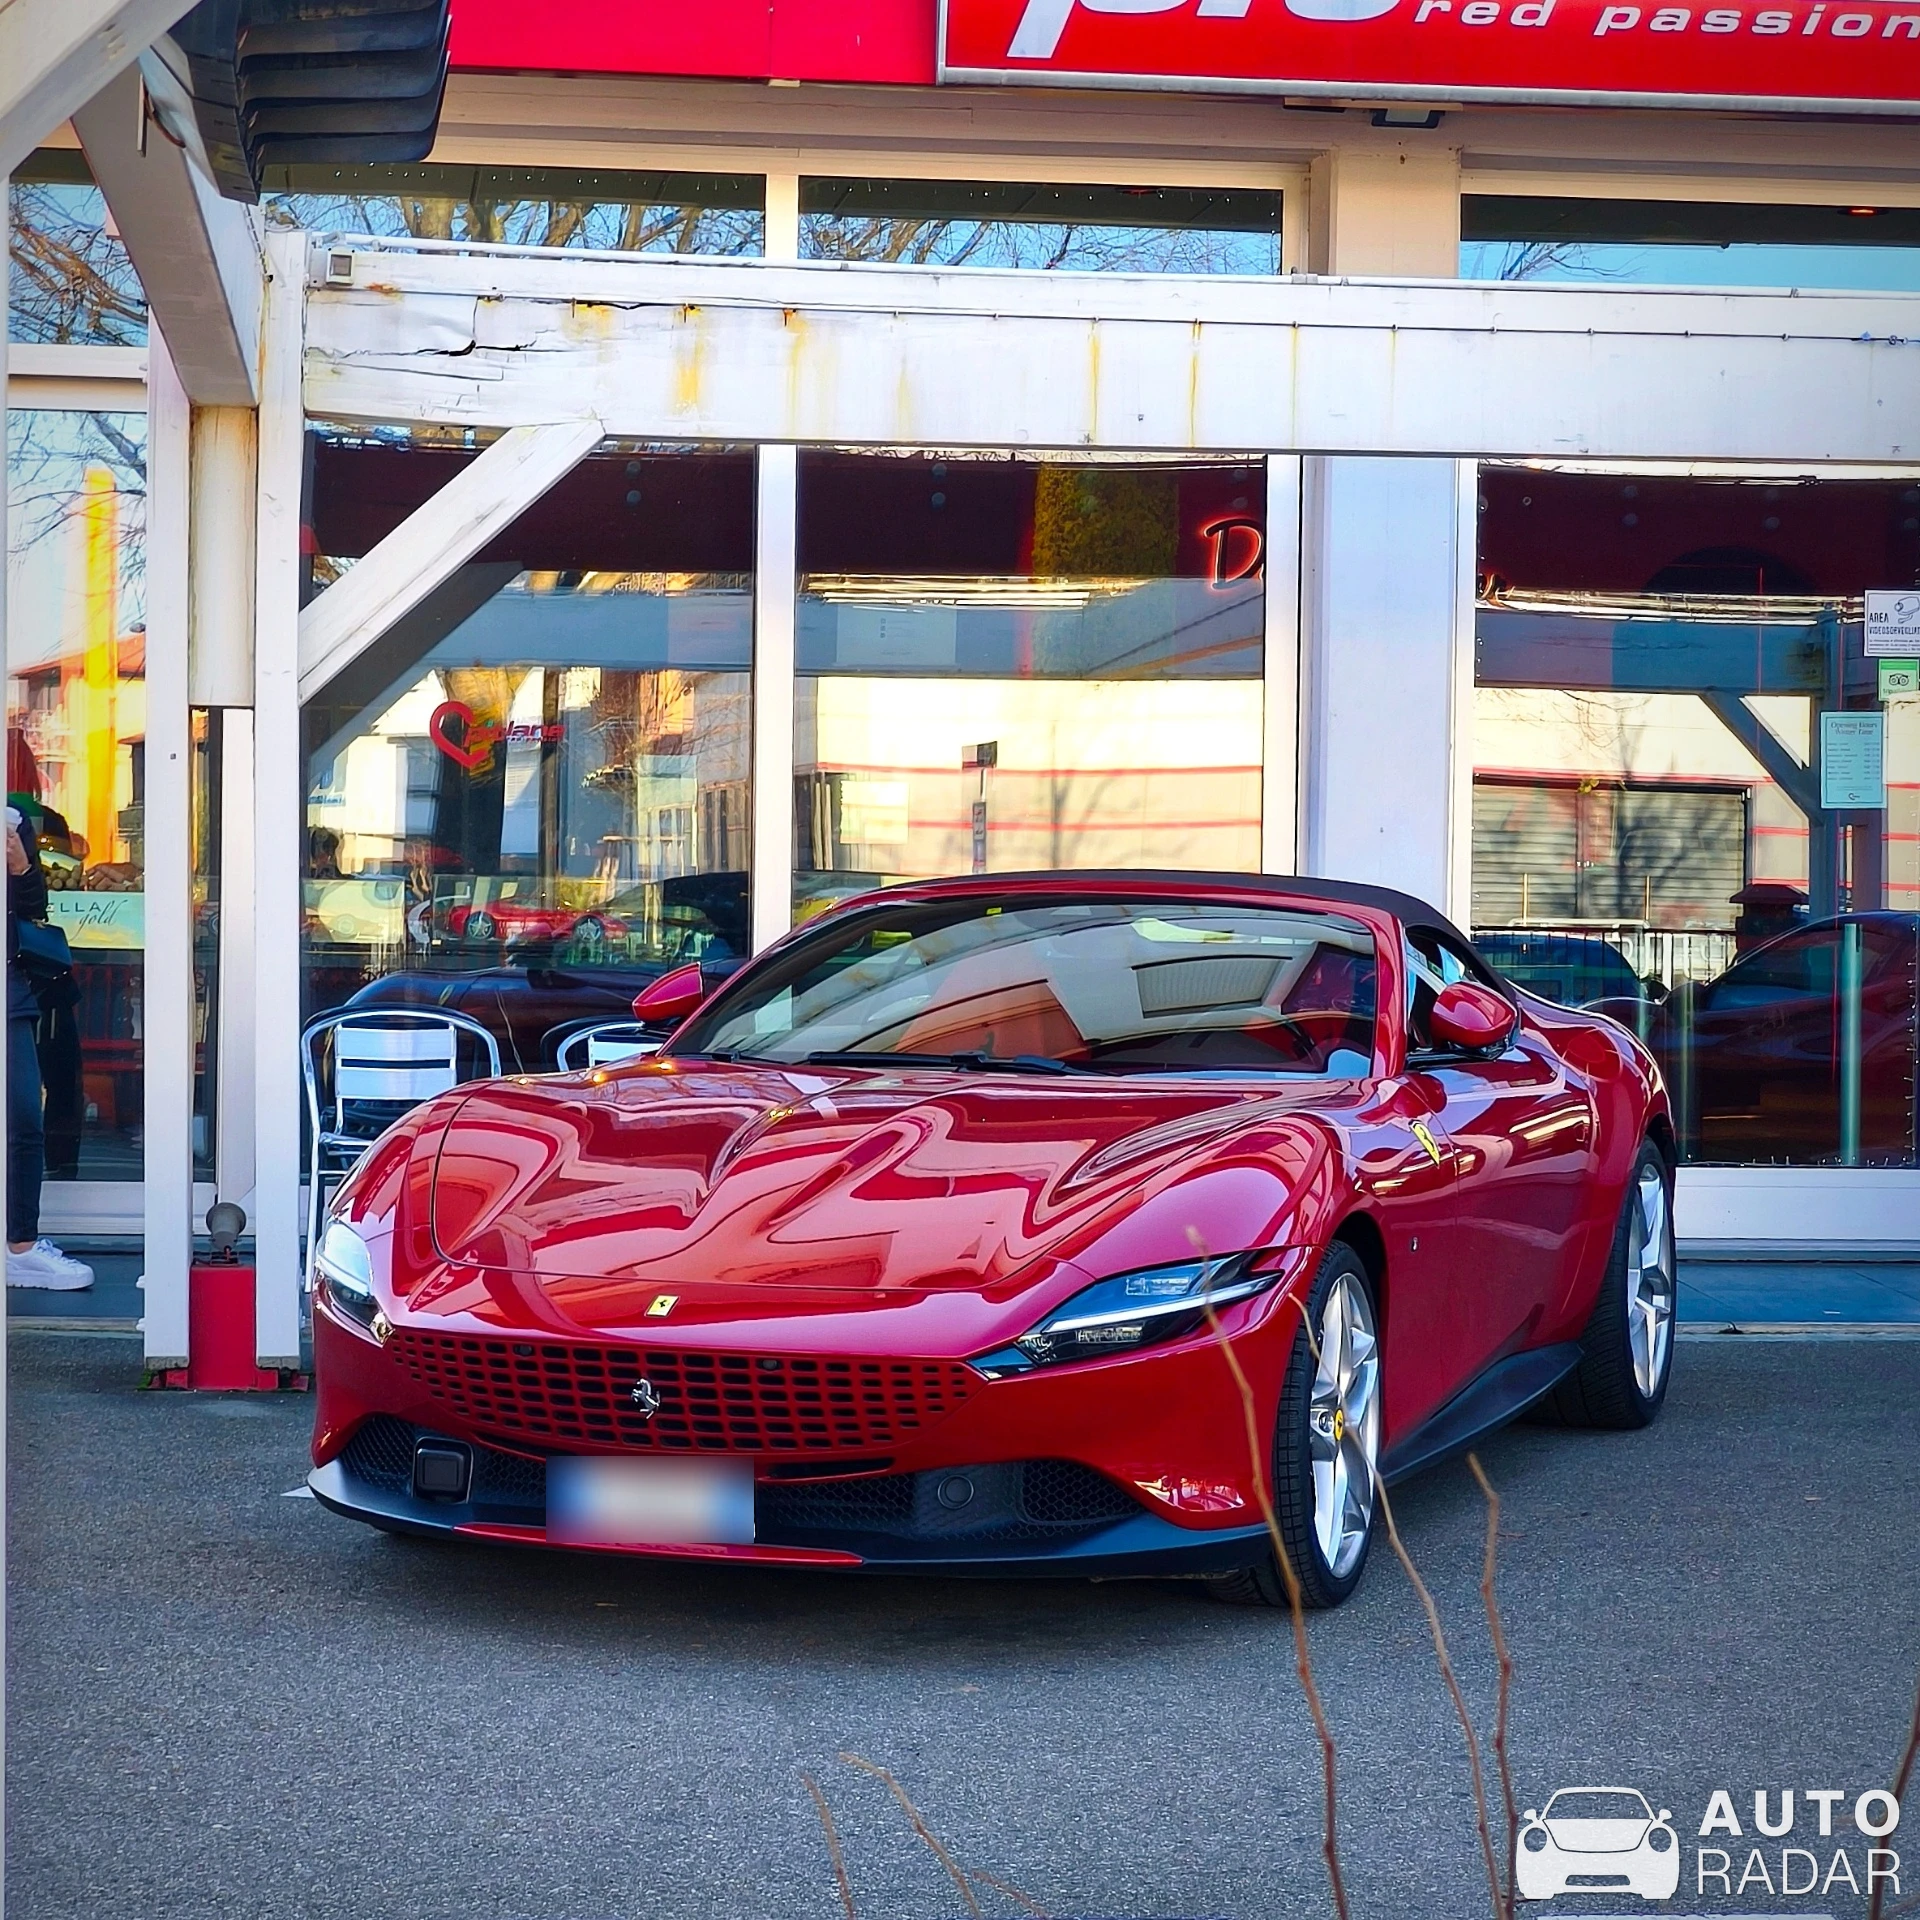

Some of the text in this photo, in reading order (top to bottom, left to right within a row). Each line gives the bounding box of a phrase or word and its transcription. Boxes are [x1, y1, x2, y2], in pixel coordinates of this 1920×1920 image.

[1414, 0, 1920, 39] red passion
[1869, 612, 1890, 623] AREA
